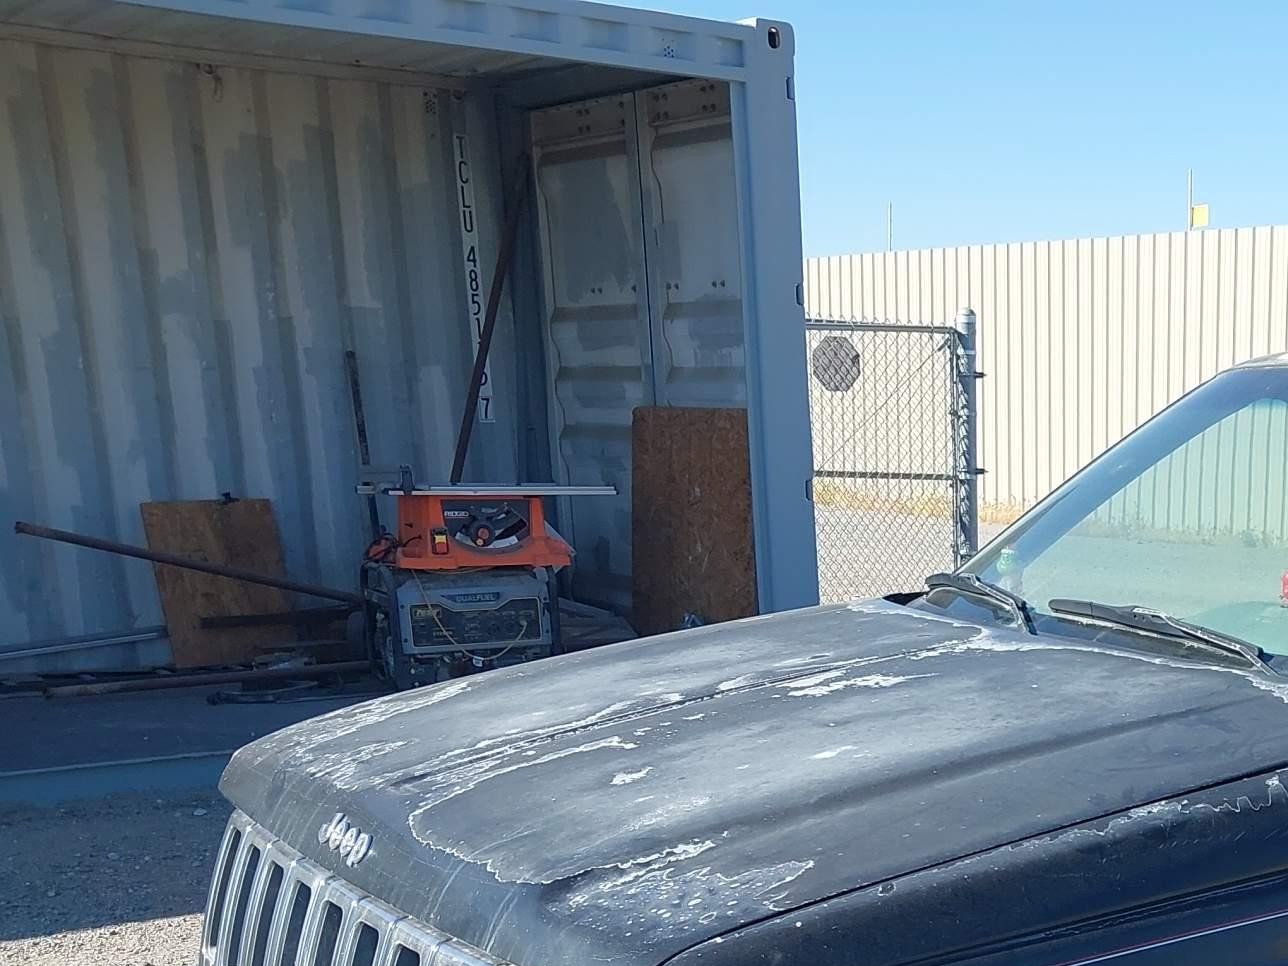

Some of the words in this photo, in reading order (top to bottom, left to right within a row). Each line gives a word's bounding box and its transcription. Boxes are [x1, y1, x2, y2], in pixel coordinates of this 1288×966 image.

[455, 135, 473, 233] TCLU
[467, 246, 489, 387] 4851
[481, 397, 490, 419] 7
[318, 812, 373, 868] Jeep
